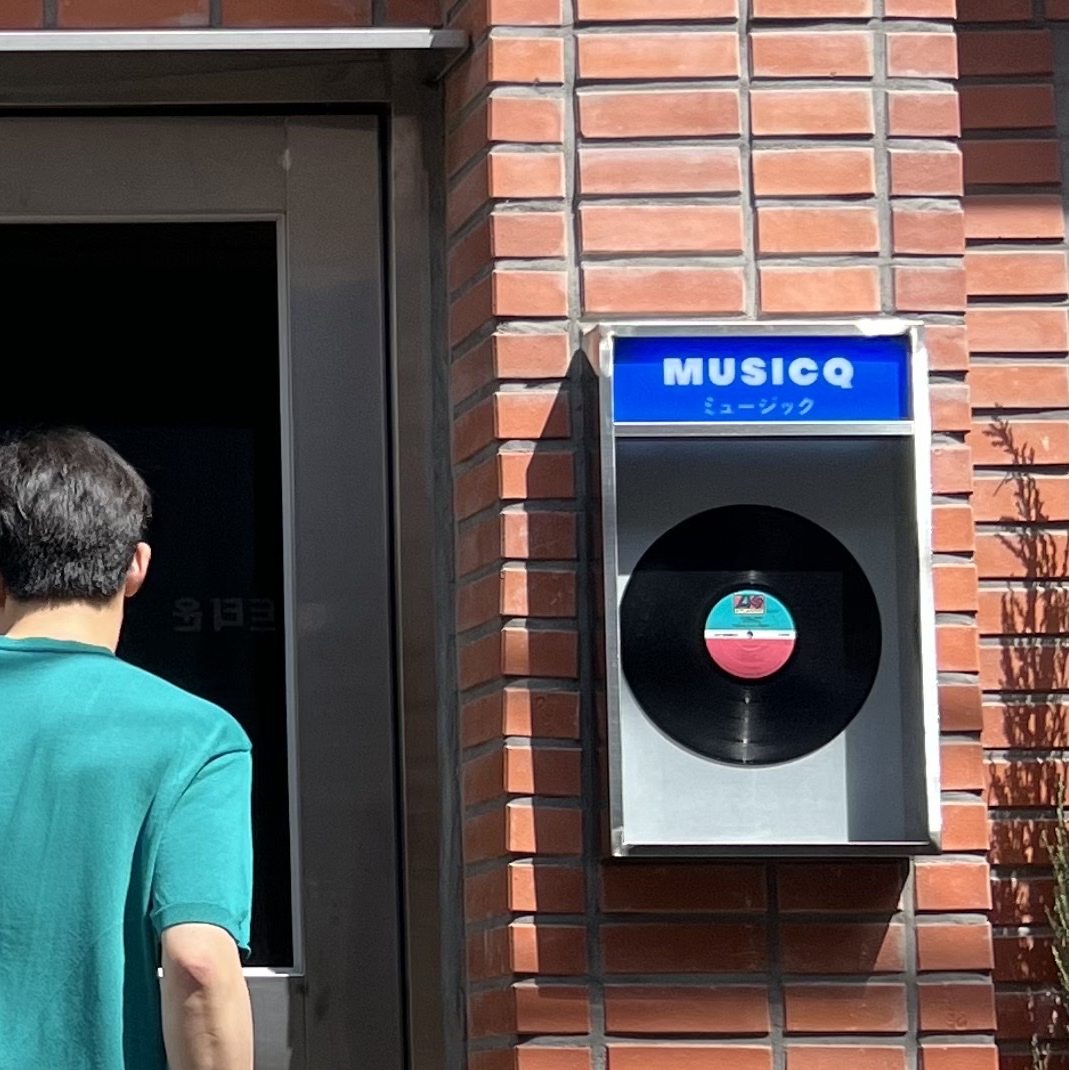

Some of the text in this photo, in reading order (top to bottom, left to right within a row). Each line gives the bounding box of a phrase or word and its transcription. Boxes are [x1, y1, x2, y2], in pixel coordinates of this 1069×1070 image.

[663, 357, 854, 389] MUSICQ
[704, 397, 814, 415] ミュージック
